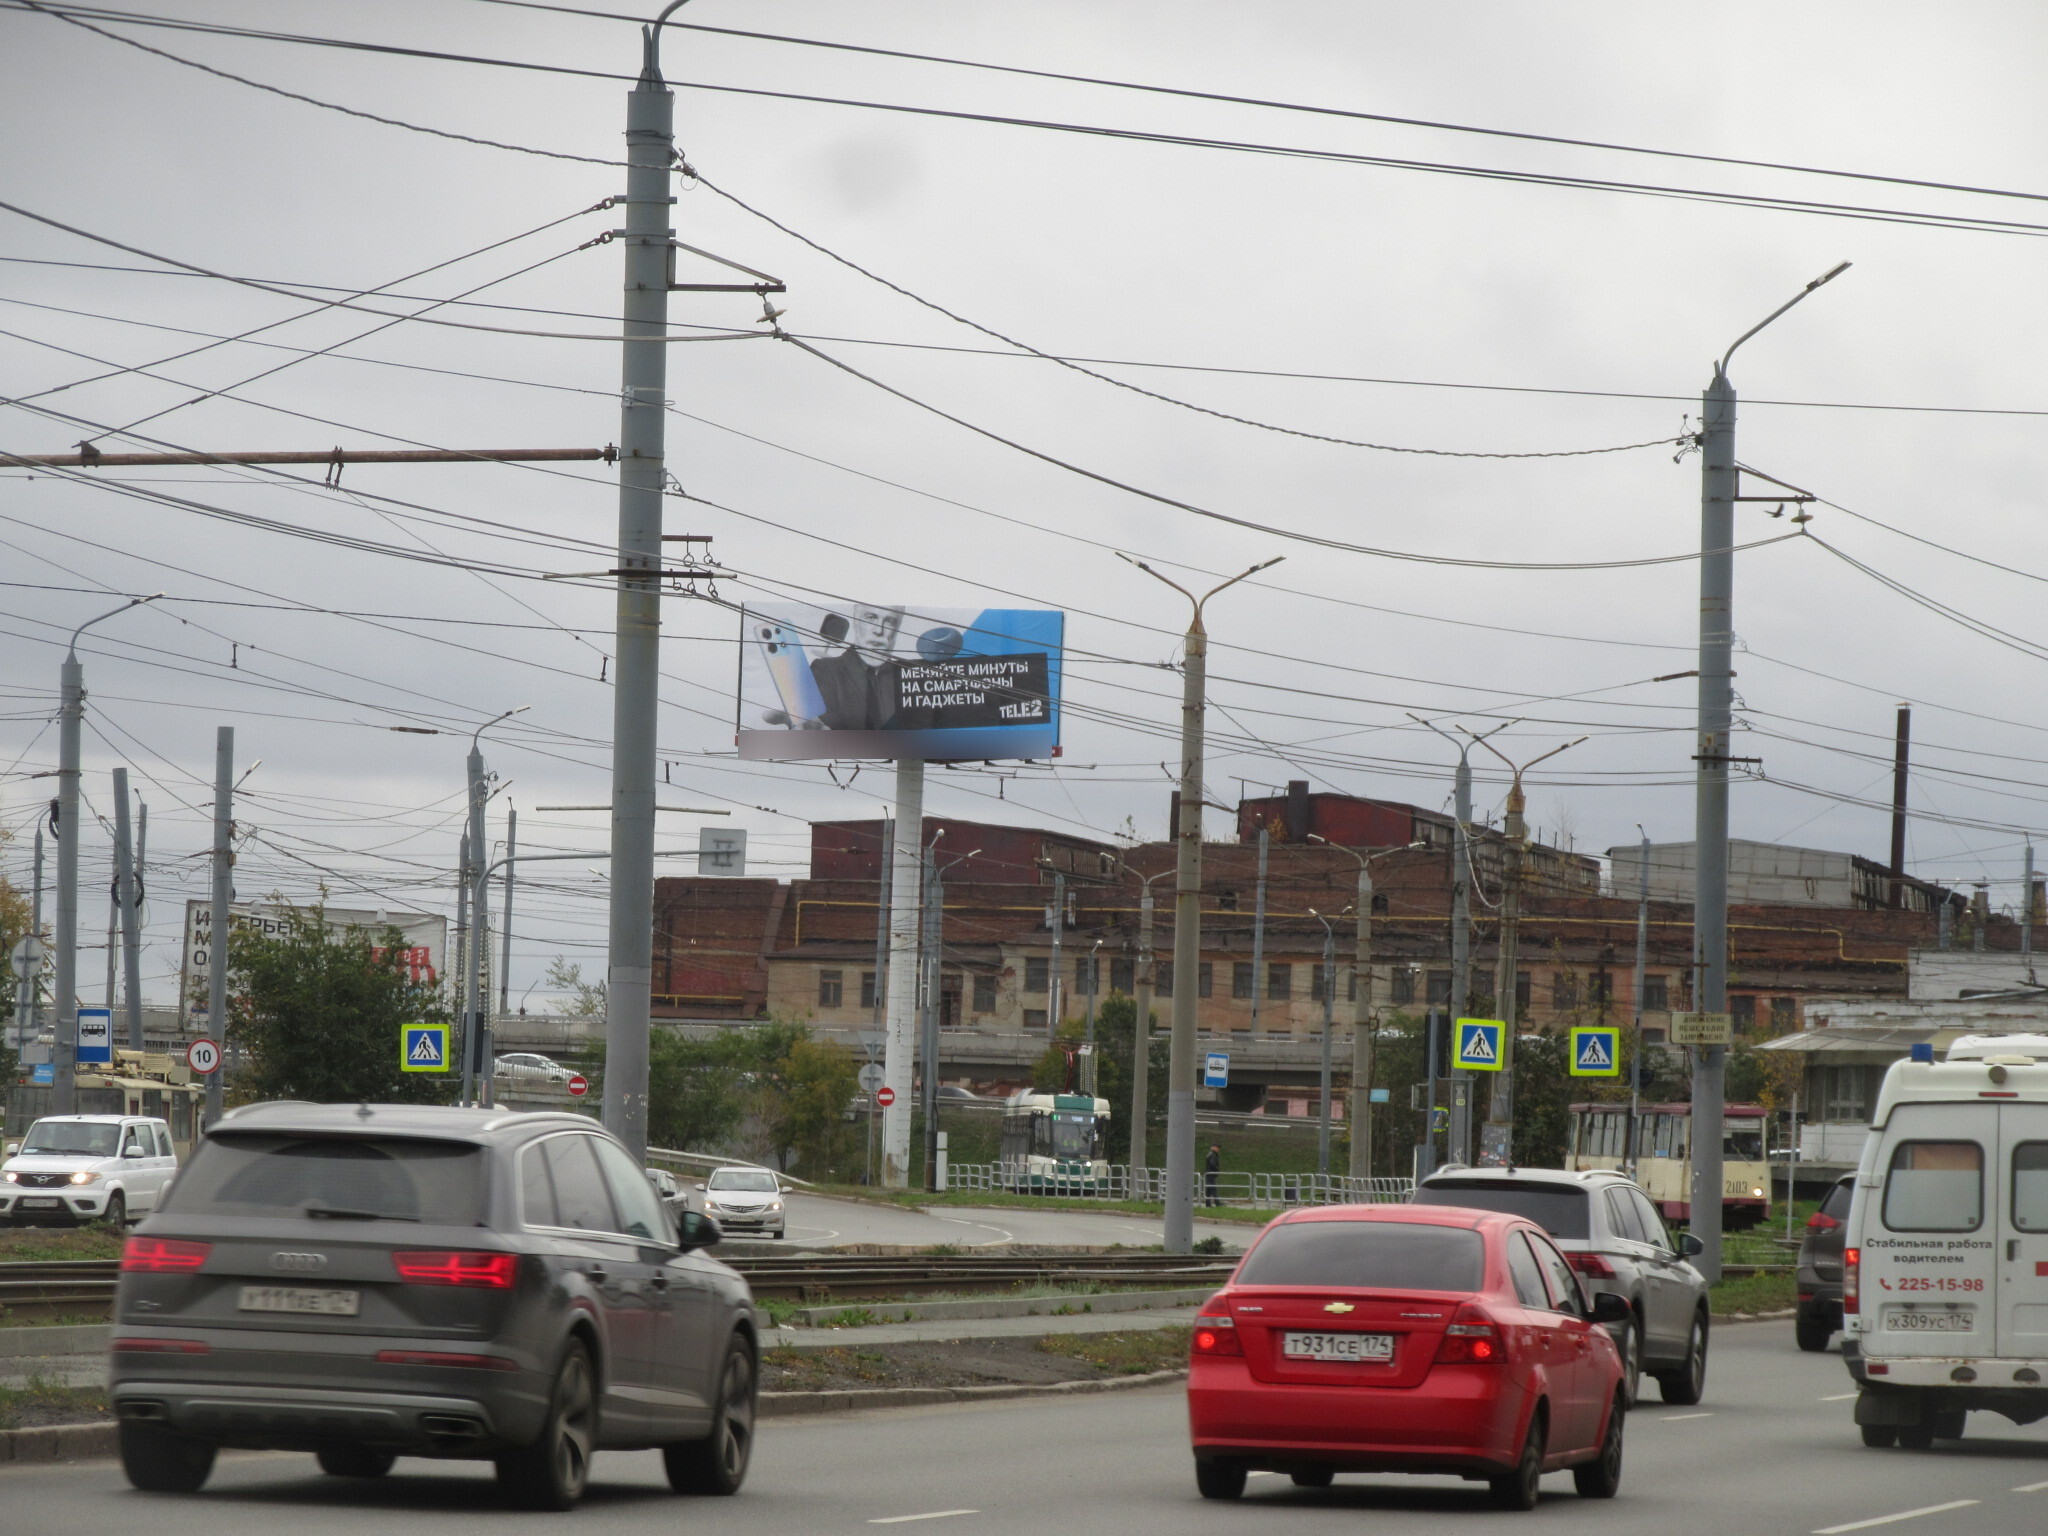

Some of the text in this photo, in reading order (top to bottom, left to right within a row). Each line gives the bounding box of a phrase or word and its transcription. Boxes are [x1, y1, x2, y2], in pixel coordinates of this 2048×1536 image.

[901, 661, 1029, 679] МЕНЯЙТЕ МИНУТЫ
[902, 676, 1013, 693] НА СМАРТФОНЫ
[903, 692, 985, 708] И ГАДЖЕТЫ
[999, 699, 1043, 718] TELE2
[195, 1049, 212, 1063] 10
[1726, 1180, 1748, 1194] 2103
[1866, 1238, 1993, 1250] Стабильная работа
[1893, 1255, 1965, 1264] водителем
[1898, 1278, 1985, 1292] 225-15-98
[1949, 1314, 1972, 1326] 174
[1291, 1336, 1388, 1354] Т931СЕ 174
